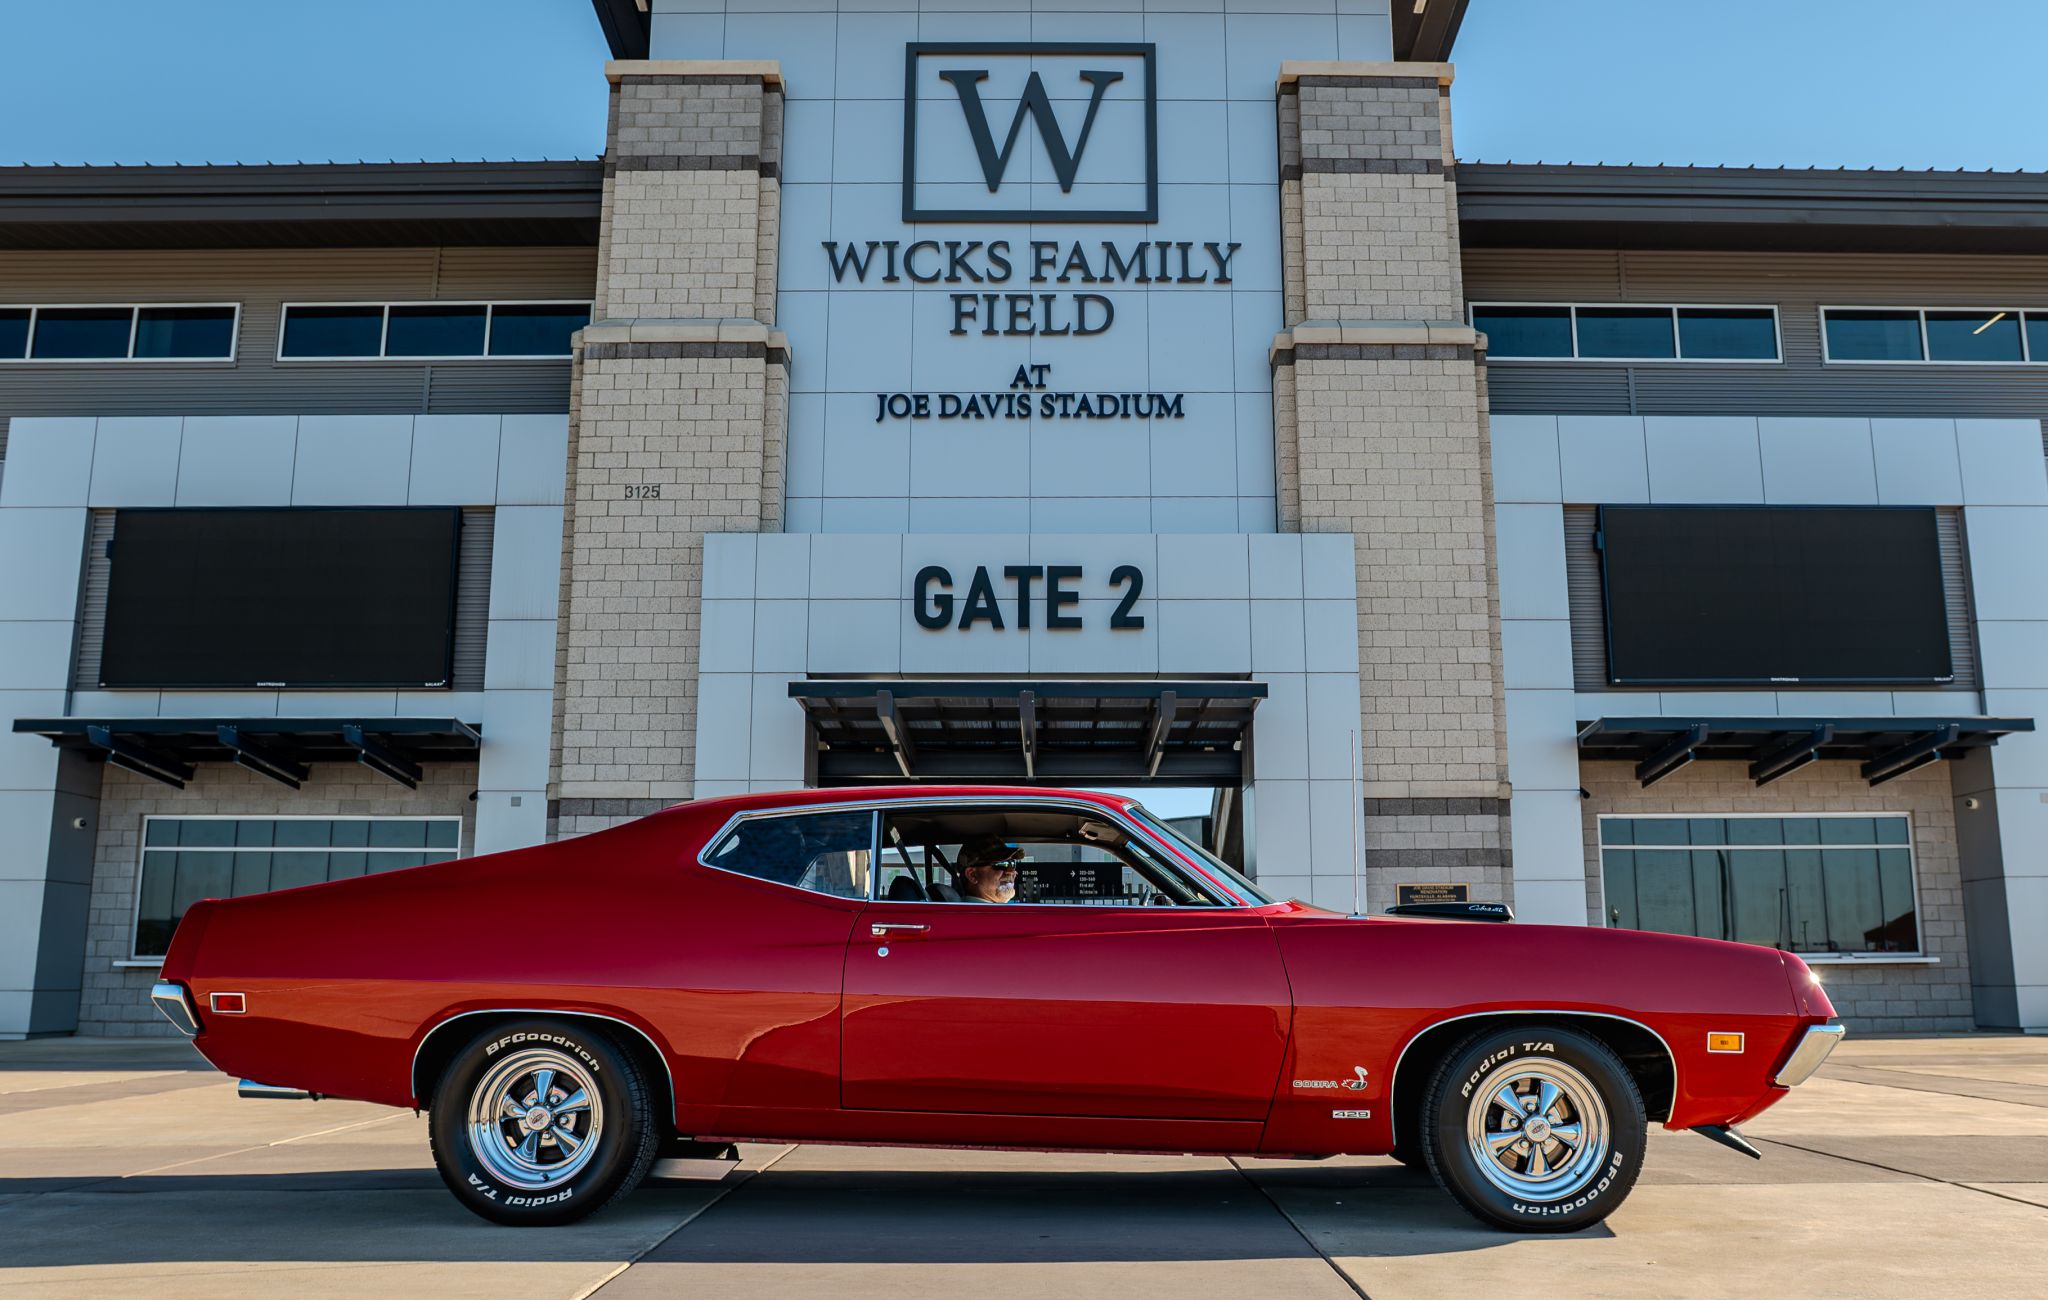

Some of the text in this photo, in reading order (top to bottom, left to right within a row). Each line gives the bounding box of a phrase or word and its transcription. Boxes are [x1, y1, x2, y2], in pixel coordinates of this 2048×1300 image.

[938, 69, 1124, 194] W
[821, 240, 1242, 284] WICKS FAMILY
[949, 293, 1115, 336] FIELD
[1010, 363, 1051, 390] AT
[875, 392, 1185, 423] JOE DAVIS STADIUM
[625, 485, 660, 498] 3125
[913, 565, 1145, 630] GATE 2
[485, 1032, 600, 1072] BFGoodrich
[1461, 1042, 1555, 1098] Radial T/A
[1292, 1080, 1338, 1089] COBRA
[1334, 1110, 1369, 1118] 429
[468, 1172, 573, 1207] Radial T/A
[1513, 1151, 1623, 1216] BFGoodrich
